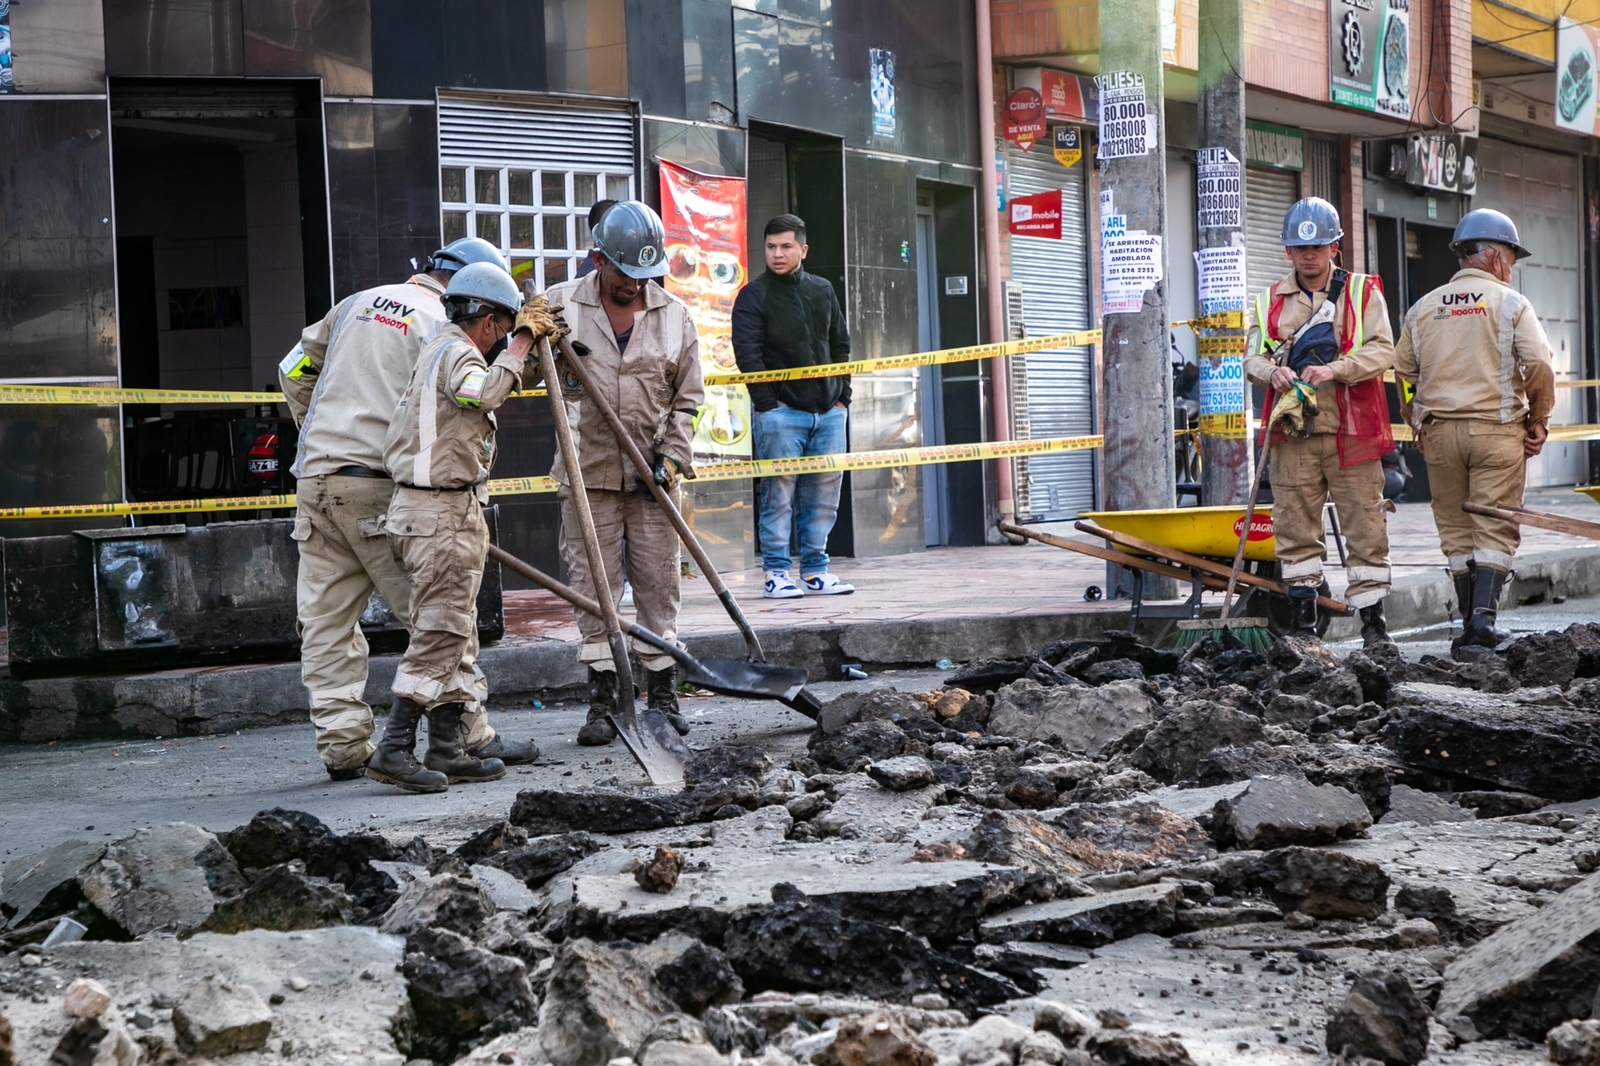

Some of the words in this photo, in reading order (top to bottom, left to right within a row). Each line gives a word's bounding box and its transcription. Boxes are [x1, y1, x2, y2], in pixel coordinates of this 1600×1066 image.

[1103, 95, 1144, 105] PENDIENTE
[1009, 101, 1035, 110] Claro
[1033, 210, 1059, 219] mobile
[1107, 216, 1125, 228] ARL
[1442, 293, 1484, 305] UMV
[373, 296, 416, 318] UMV
[1043, 341, 1068, 349] PELIGRO
[973, 351, 998, 359] PELIGRO
[1235, 522, 1274, 532] HRAGR
